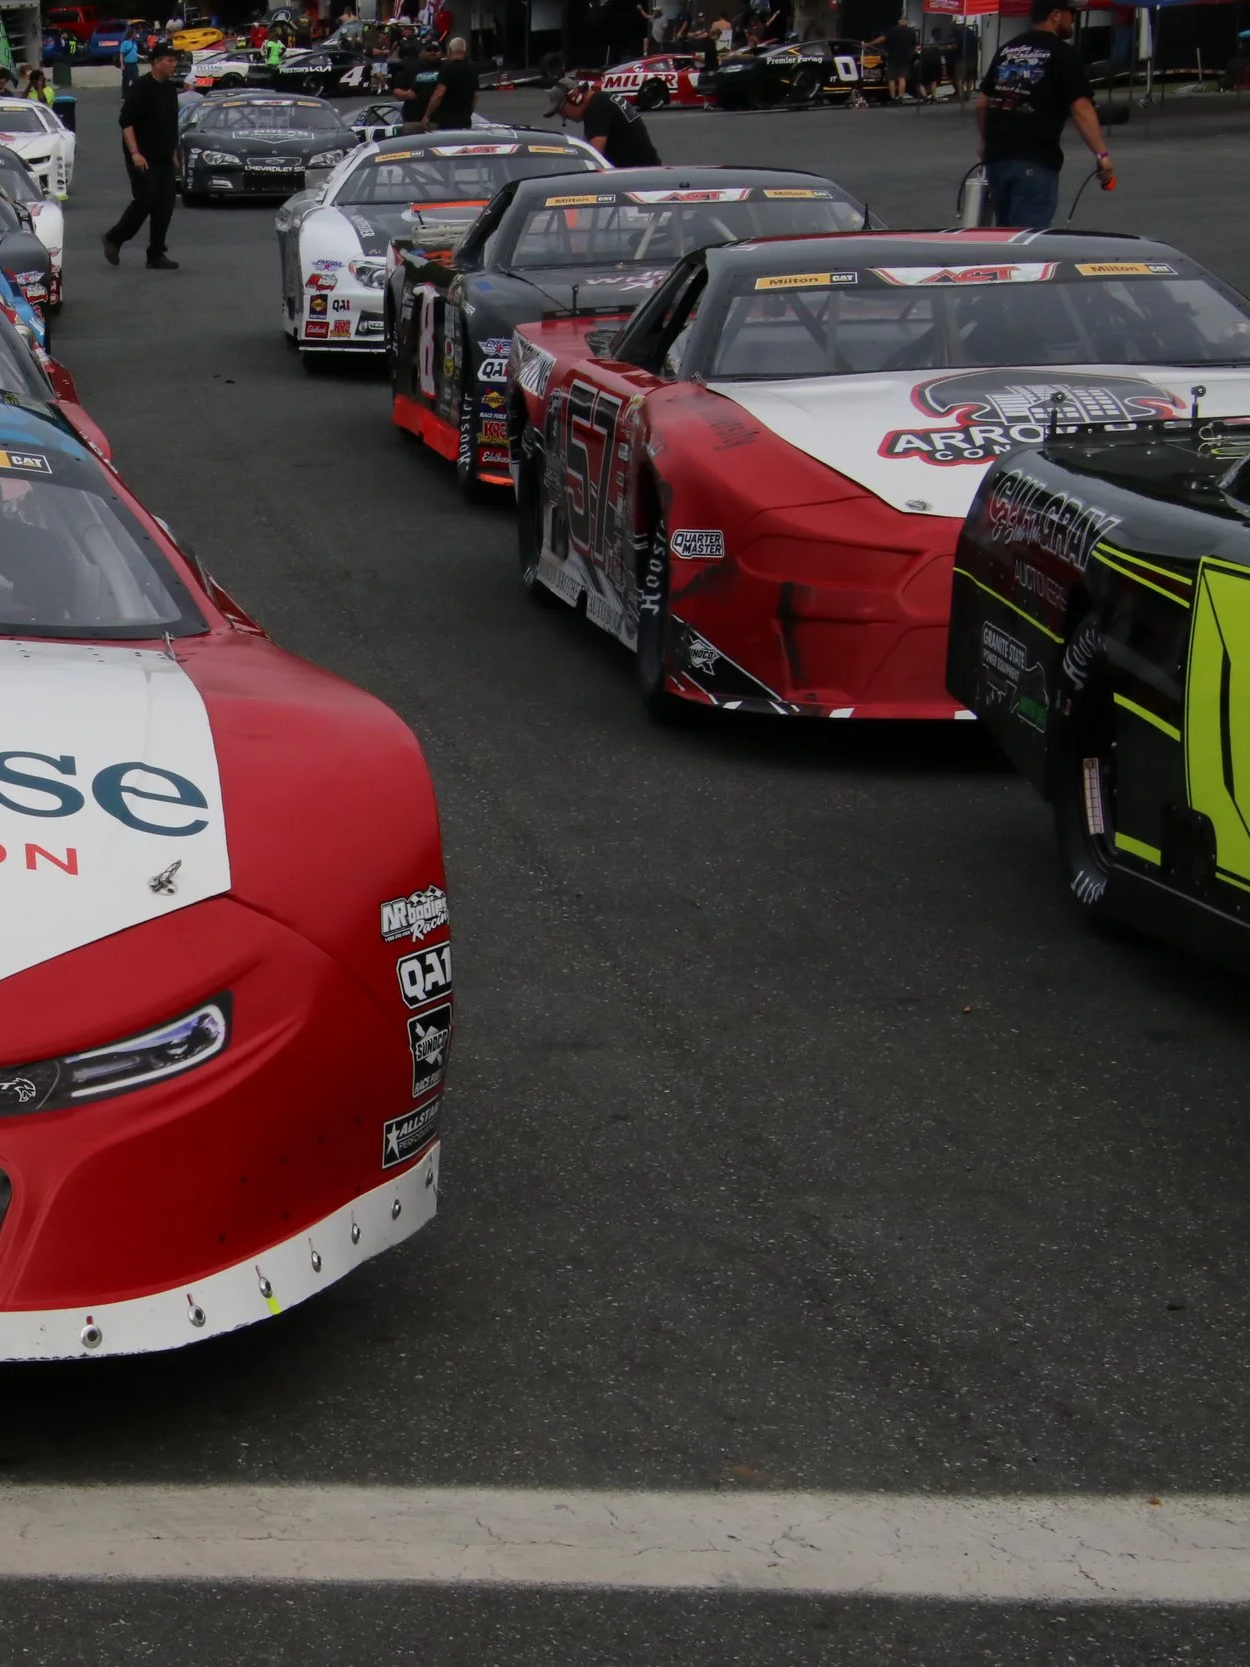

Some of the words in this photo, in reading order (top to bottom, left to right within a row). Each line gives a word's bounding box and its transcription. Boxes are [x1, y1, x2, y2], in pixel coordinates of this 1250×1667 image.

[339, 65, 365, 86] 4
[555, 196, 589, 204] Milton
[918, 266, 1021, 284] ACT
[1090, 263, 1139, 275] Milton
[1150, 264, 1171, 275] CAT
[769, 274, 819, 287] Milton
[831, 273, 854, 283] CAT
[11, 454, 42, 468] CAT
[565, 379, 623, 562] 57
[674, 533, 721, 547] QUARTER
[681, 543, 722, 554] MASTER
[401, 946, 452, 1000] QA1
[417, 1031, 448, 1060] SUNOCO
[414, 1077, 430, 1094] RACE
[398, 1101, 439, 1136] ALLSTAR
